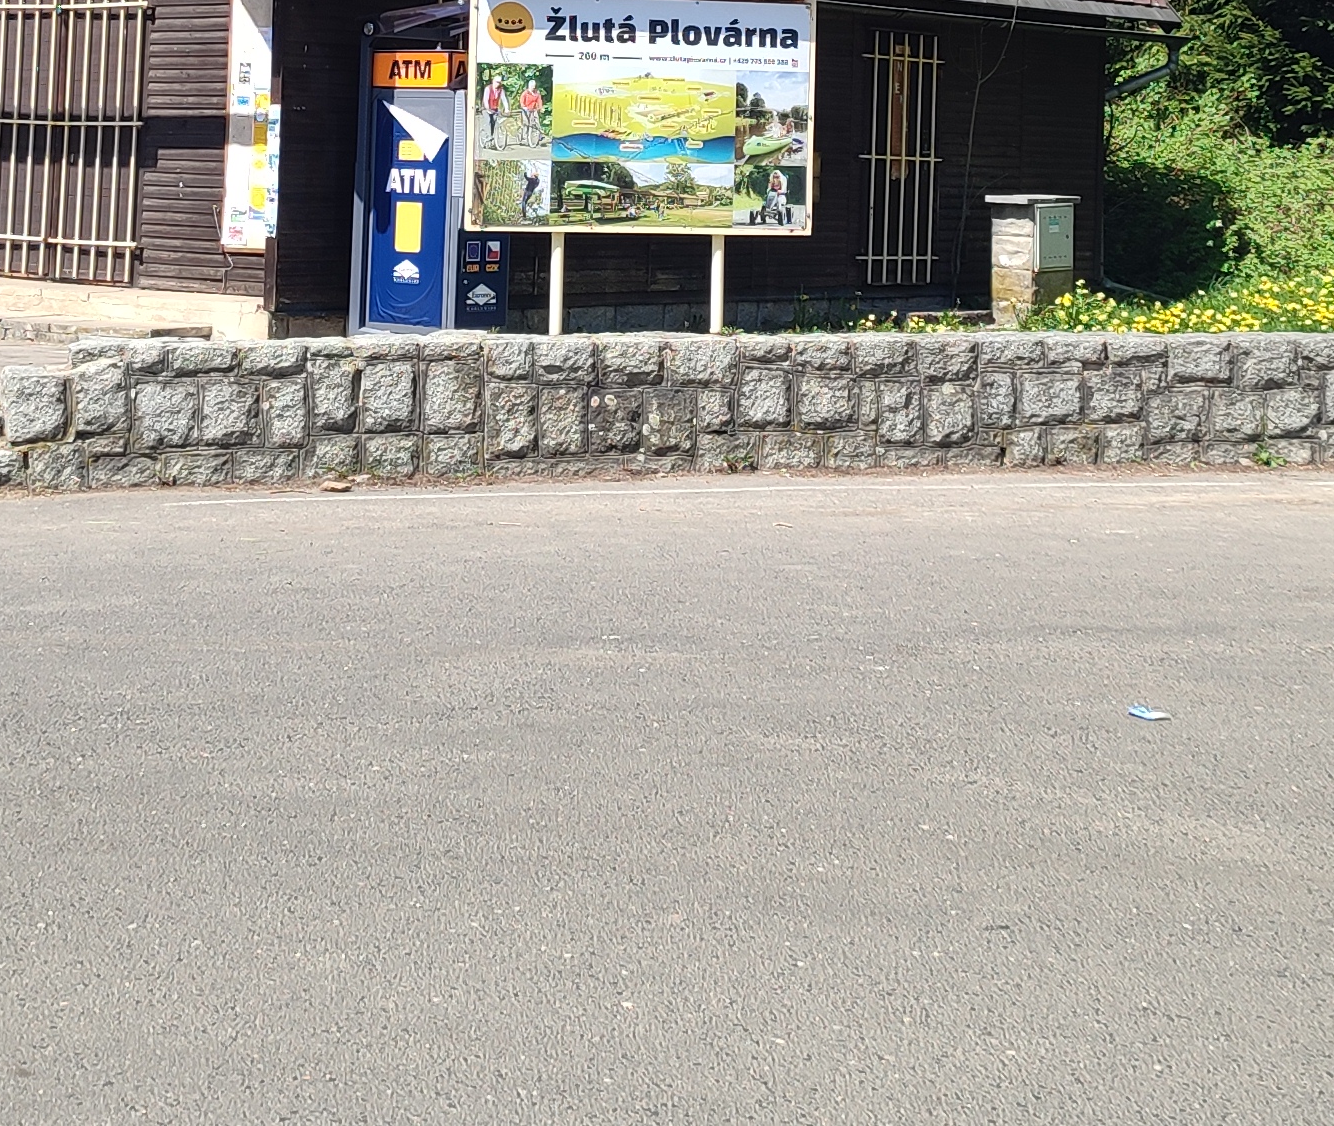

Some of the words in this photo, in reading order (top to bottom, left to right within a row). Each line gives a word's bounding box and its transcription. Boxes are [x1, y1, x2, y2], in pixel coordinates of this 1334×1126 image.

[544, 6, 637, 43] Žlutá
[648, 18, 799, 49] Plovárna
[389, 60, 431, 80] ATM
[385, 168, 436, 194] ATM
